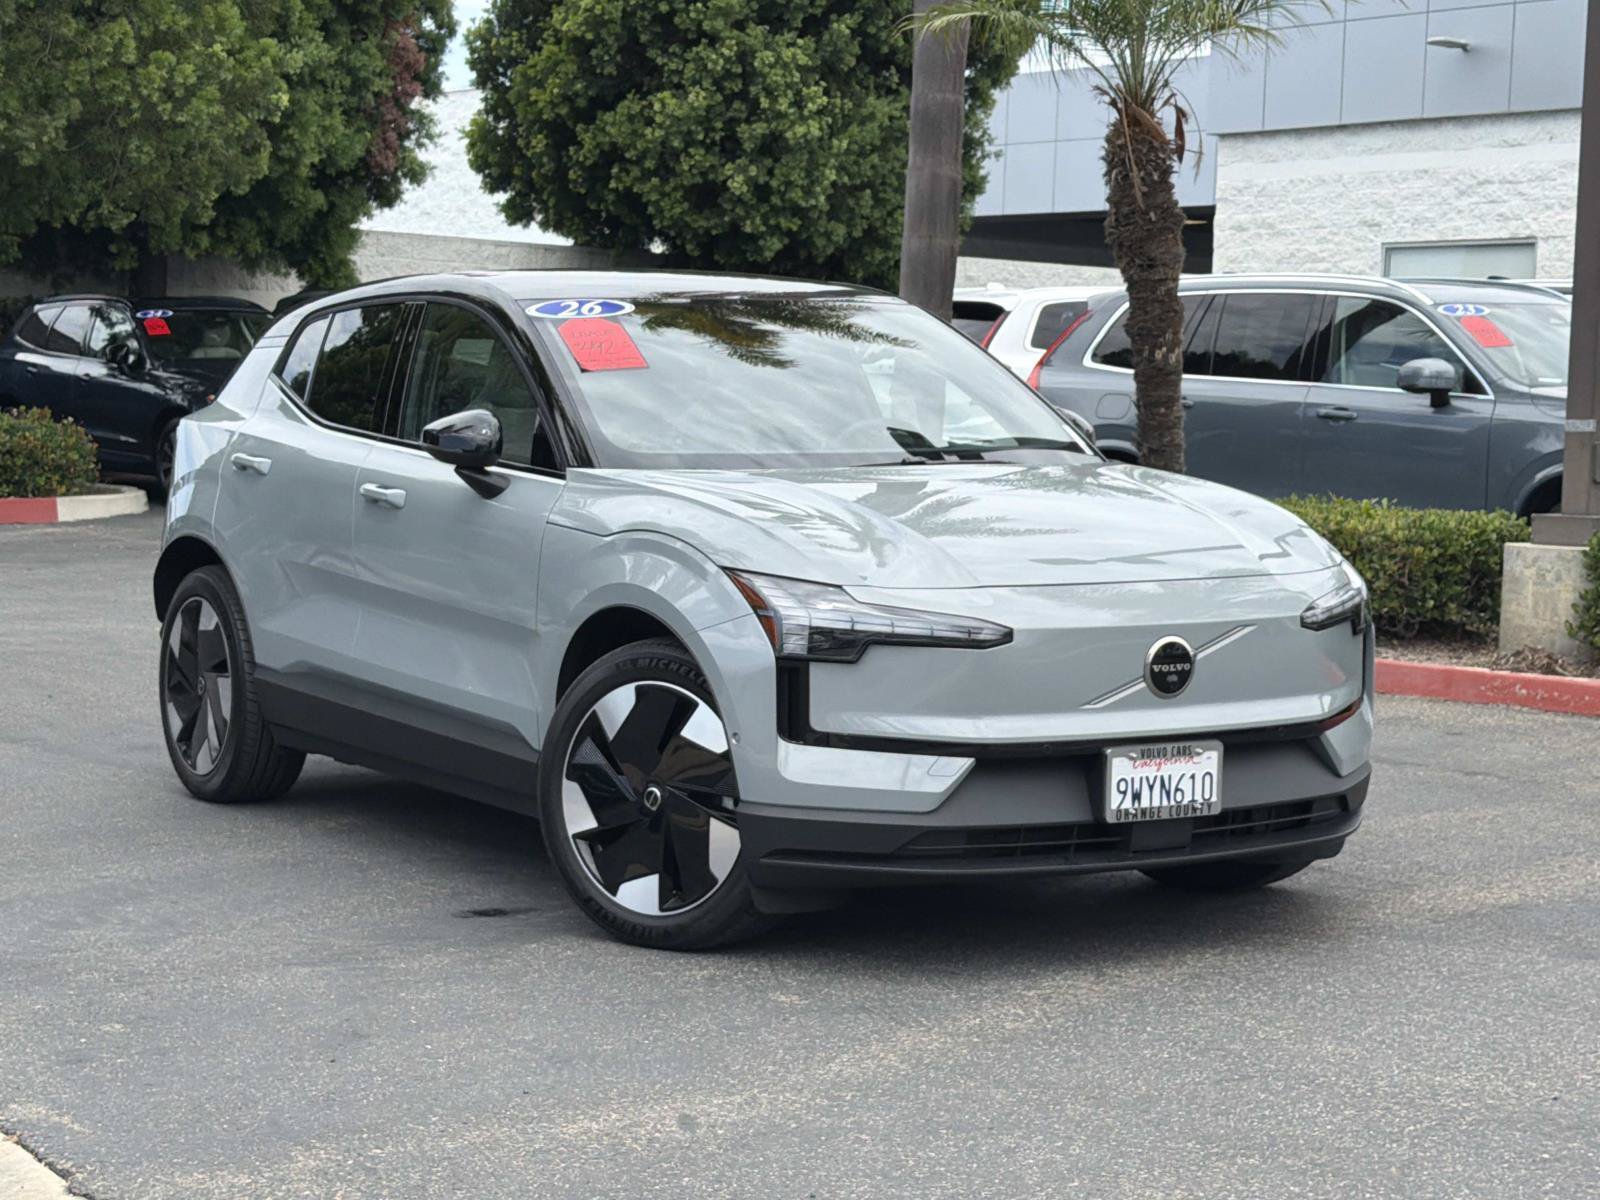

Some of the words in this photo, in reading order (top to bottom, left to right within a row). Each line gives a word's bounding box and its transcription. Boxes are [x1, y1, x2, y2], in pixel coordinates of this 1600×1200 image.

[558, 300, 603, 316] 26
[638, 658, 709, 686] MICHELI
[1152, 663, 1191, 672] VOLVO
[1140, 746, 1168, 759] VOLVO
[1171, 744, 1193, 757] CARS
[1116, 771, 1214, 810] 9WYN610
[1116, 804, 1162, 821] ORANGE
[1168, 801, 1213, 817] COUNTY
